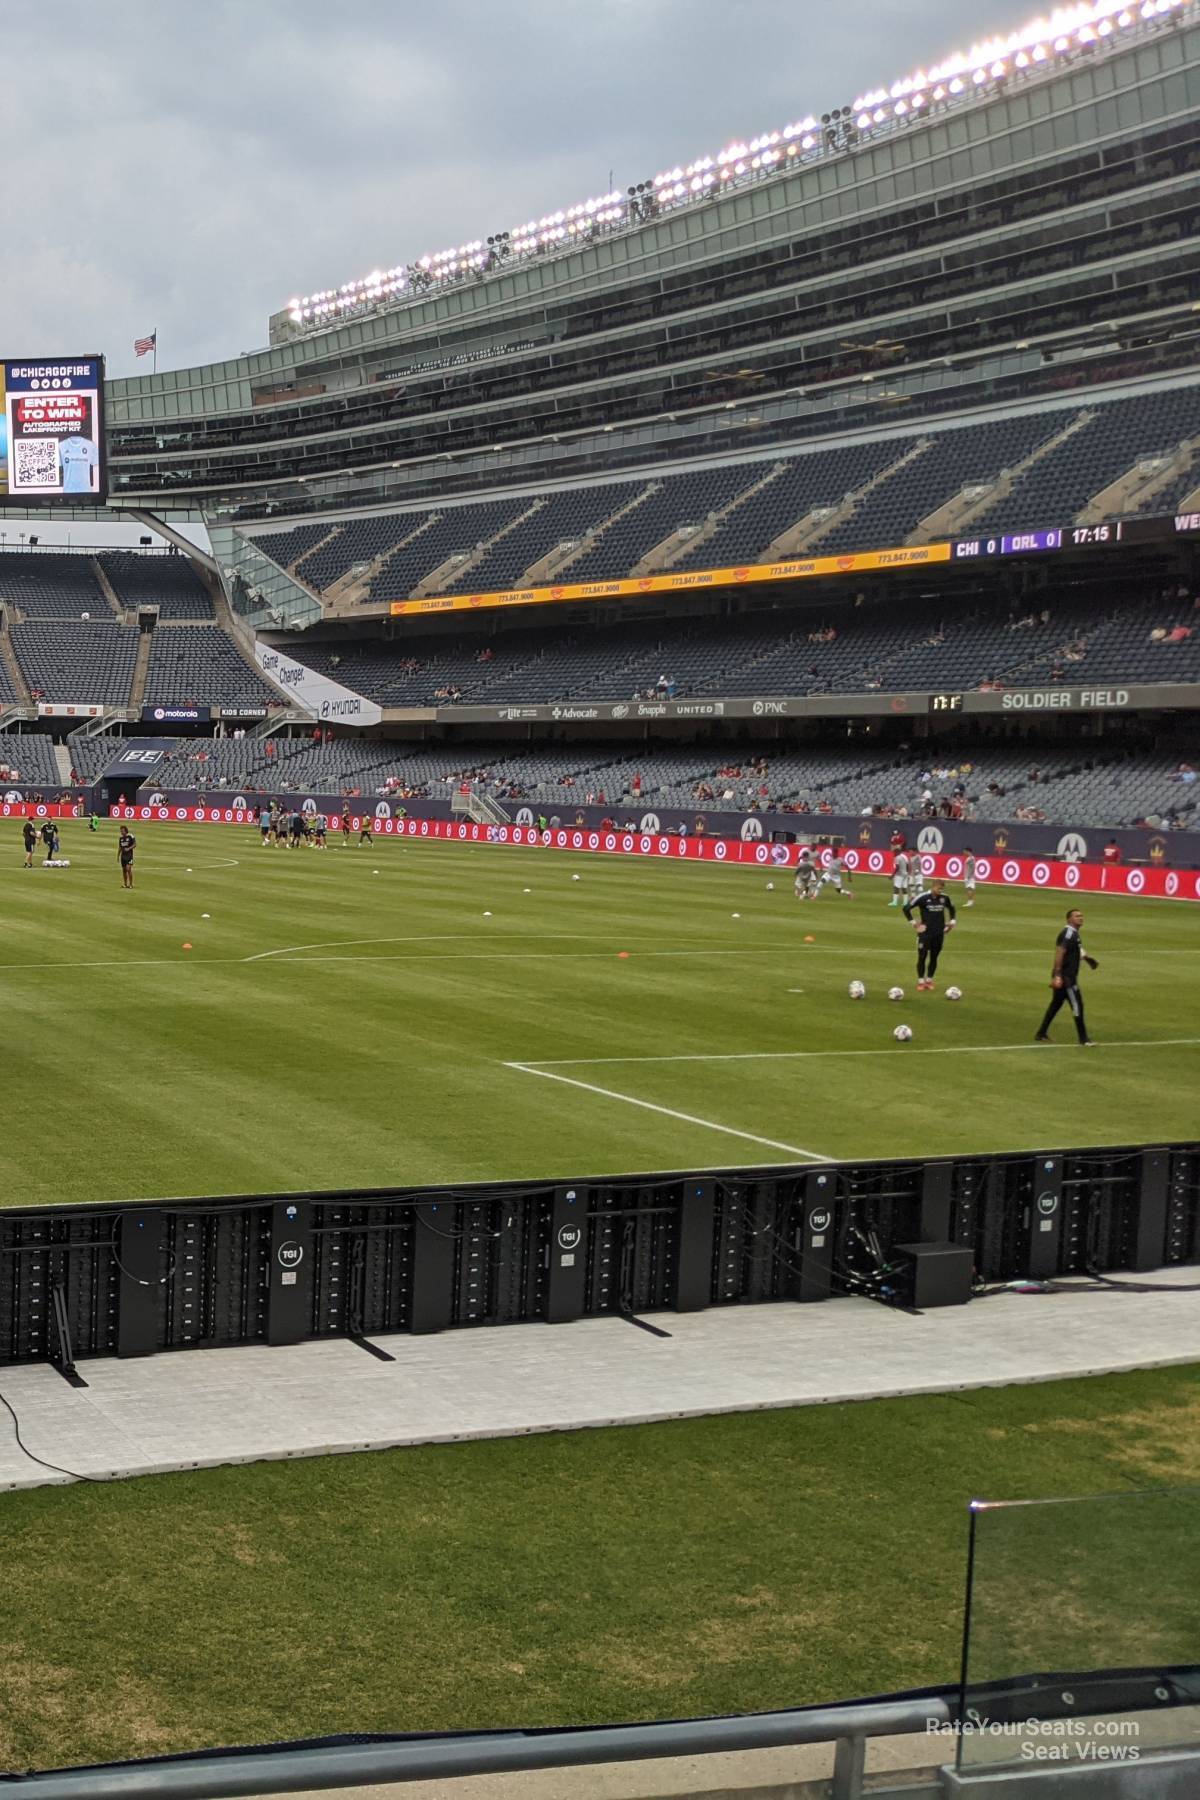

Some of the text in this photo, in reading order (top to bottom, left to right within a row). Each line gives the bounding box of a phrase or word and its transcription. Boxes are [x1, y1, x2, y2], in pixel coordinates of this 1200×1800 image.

[11, 365, 90, 378] @CHICAGOFIRE
[24, 397, 79, 408] ENTER
[21, 408, 82, 419] TO WIN
[956, 527, 1109, 557] CHI 0 ORL 0 17:15
[262, 653, 279, 671] Game
[279, 666, 306, 686] Changer.
[1002, 690, 1129, 709] SOLDIER FIELD
[221, 708, 266, 717] KIDS CORNER
[331, 699, 361, 715] HYUNDAI
[562, 708, 598, 718] Advocate
[638, 704, 666, 717] Snapple
[677, 705, 713, 715] UNITED
[764, 702, 787, 713] PNC
[165, 709, 198, 718] motorola
[507, 708, 521, 719] Lite
[1041, 1197, 1054, 1208] TGI
[813, 1214, 827, 1226] TGI
[561, 1231, 576, 1243] TGI
[282, 1249, 298, 1261] TGI
